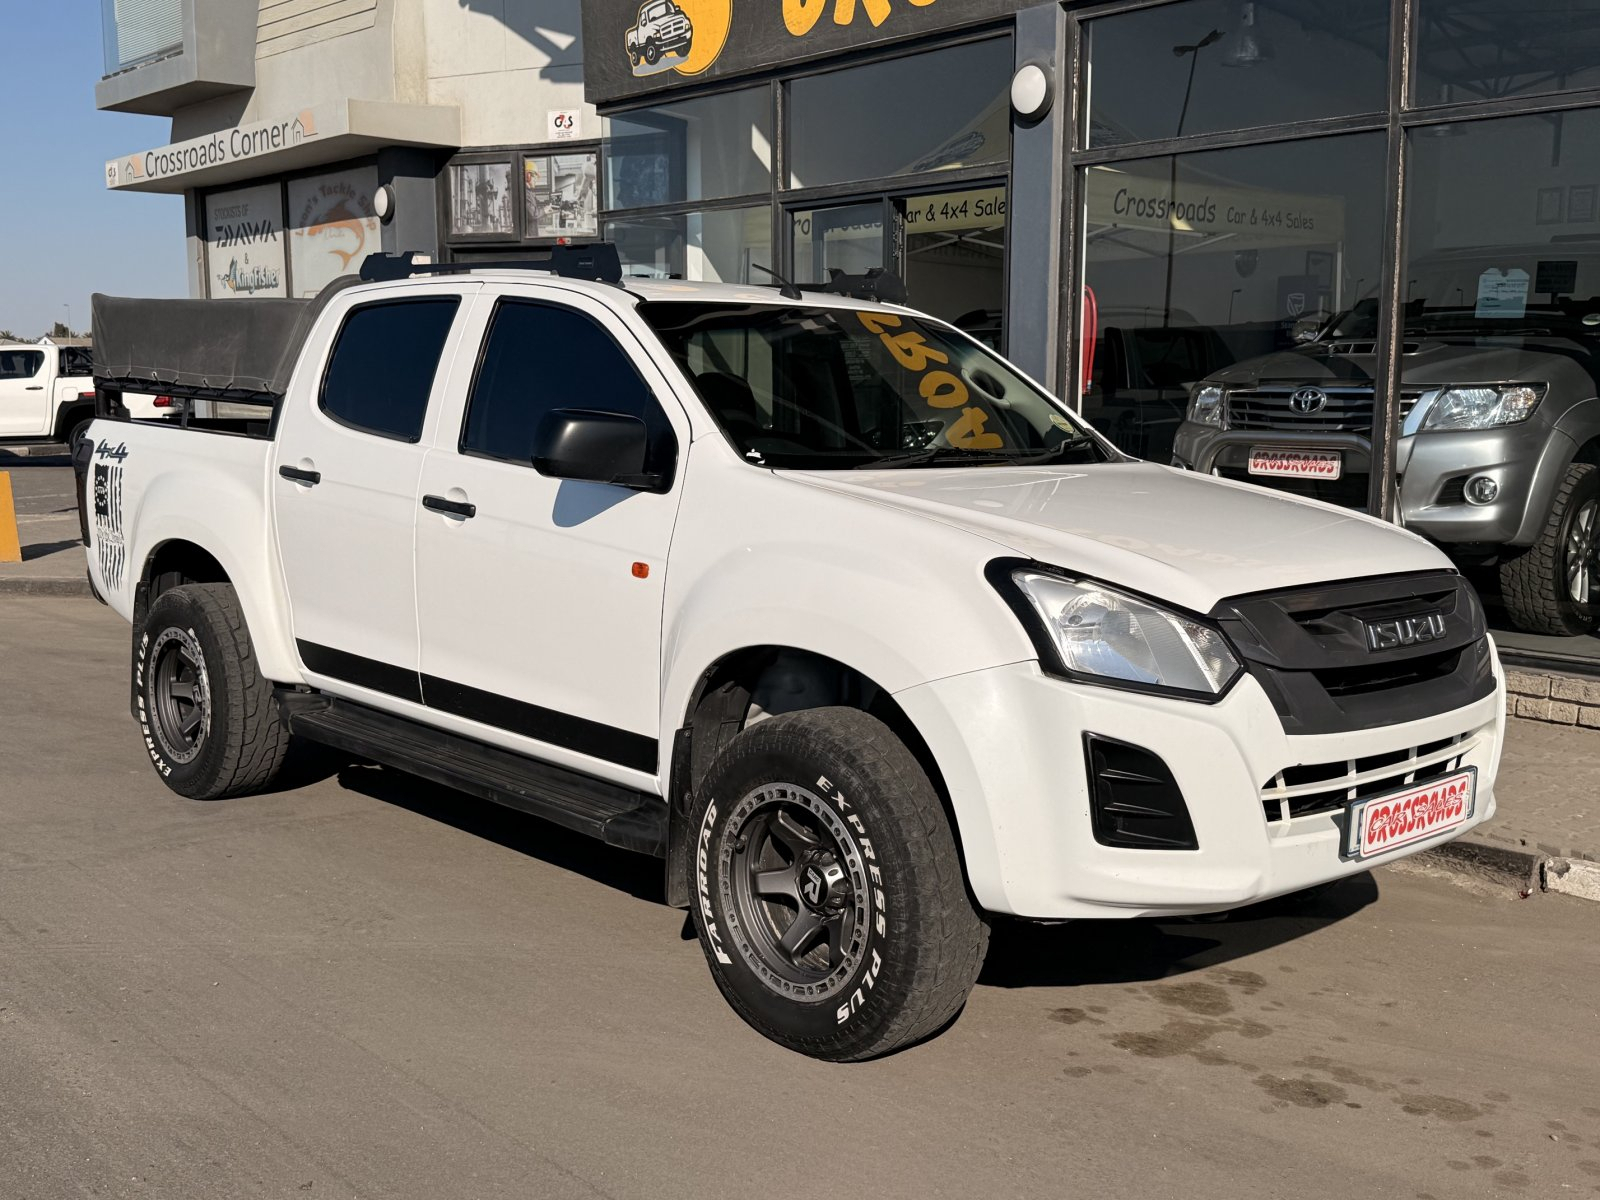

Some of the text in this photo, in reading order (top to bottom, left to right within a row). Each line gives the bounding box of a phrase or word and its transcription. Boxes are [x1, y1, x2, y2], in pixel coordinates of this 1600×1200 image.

[145, 134, 225, 179] Crossroads
[230, 120, 289, 158] Corner
[318, 182, 356, 199] Tackle
[214, 203, 249, 221] STOCKISTS OF
[906, 196, 1006, 224] ar & 4x4 Sale
[1113, 188, 1315, 231] Crossroads Car & 4x4 Sales
[244, 252, 249, 265] &
[95, 438, 129, 465] 4x4
[1252, 451, 1337, 474] CROSSROADS
[1367, 614, 1447, 650] ISUZU
[136, 631, 172, 777] EXPRESS PLUS
[1367, 781, 1466, 845] CROSSROADS
[1370, 794, 1464, 832] CAR SALES
[697, 797, 733, 965] FARROAD
[815, 775, 887, 1025] EXPRESS PLUS
